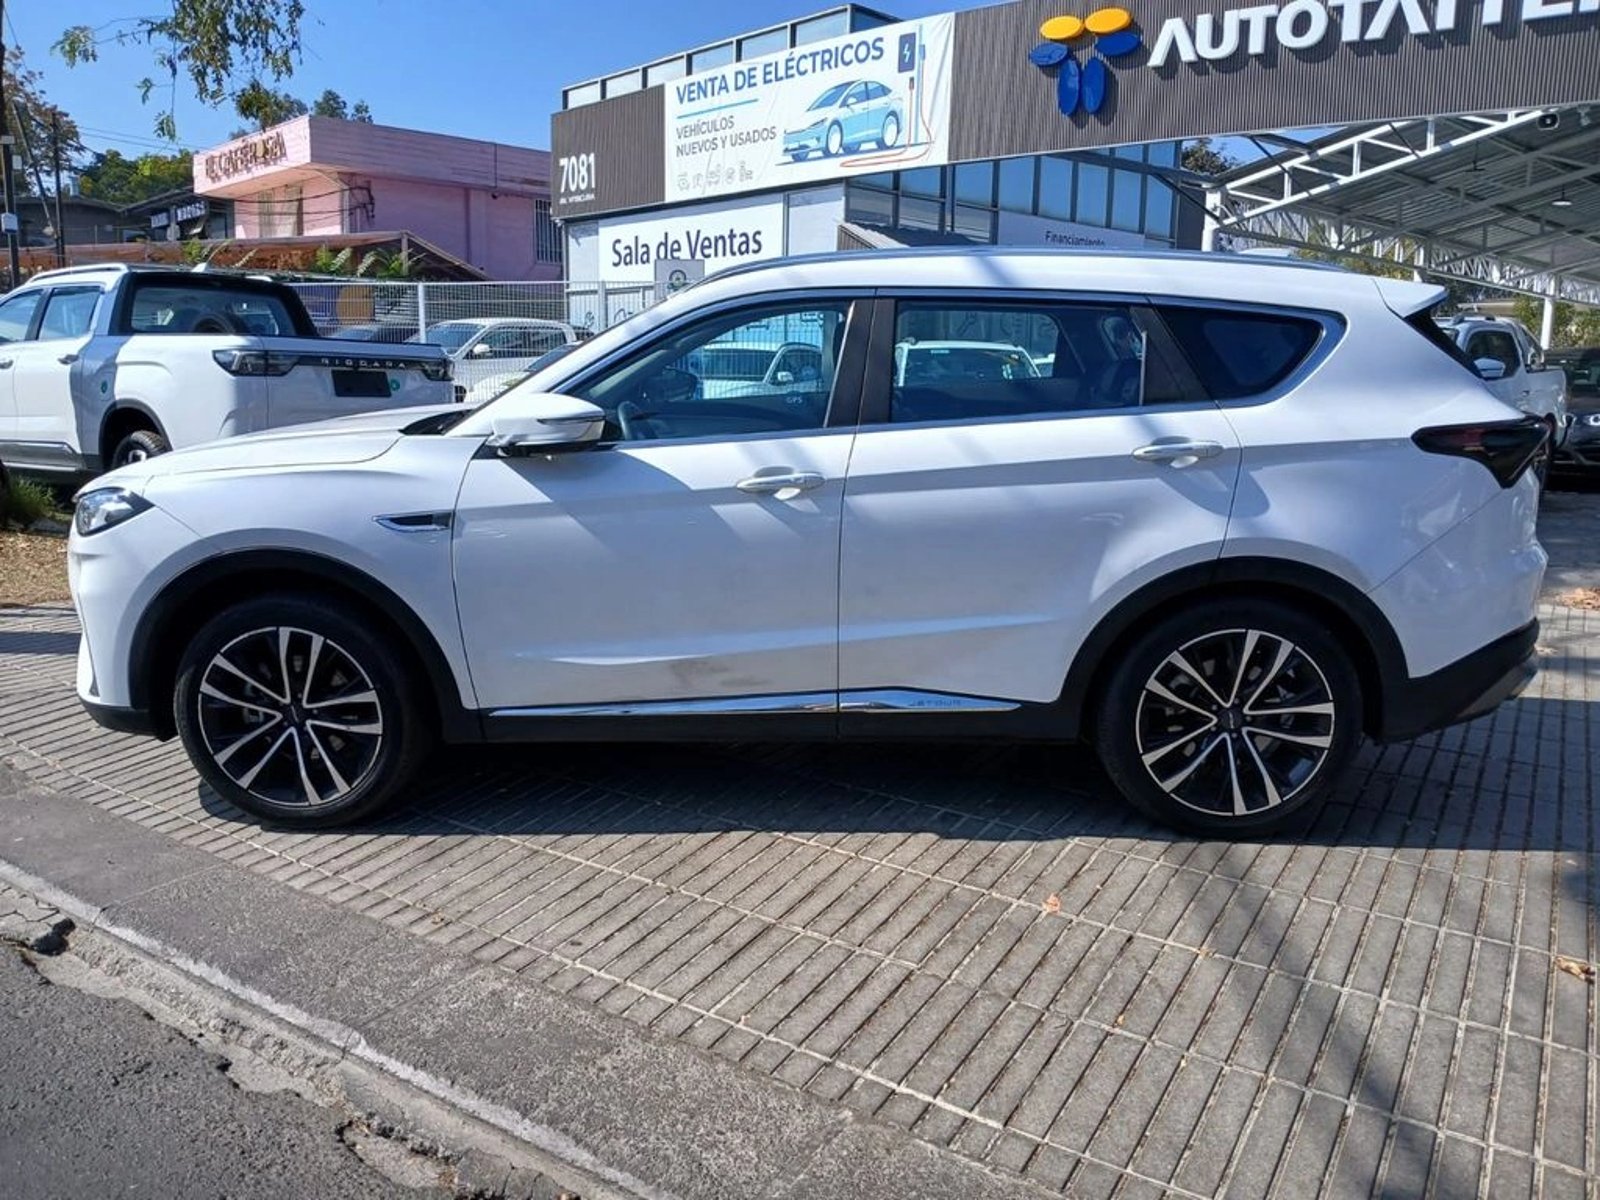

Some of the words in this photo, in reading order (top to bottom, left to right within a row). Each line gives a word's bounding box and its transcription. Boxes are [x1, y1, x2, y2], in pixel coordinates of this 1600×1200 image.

[675, 74, 730, 105] VENTA
[734, 66, 758, 92] DE
[762, 36, 884, 85] ELÉCTRICOS
[676, 115, 735, 139] VEHÍCULOS
[676, 137, 718, 158] NUEVOS
[720, 135, 728, 149] Y
[730, 126, 777, 148] USADOS
[559, 152, 595, 194] 7081
[612, 235, 651, 267] Sala
[655, 231, 682, 260] de
[685, 228, 763, 260] Ventas
